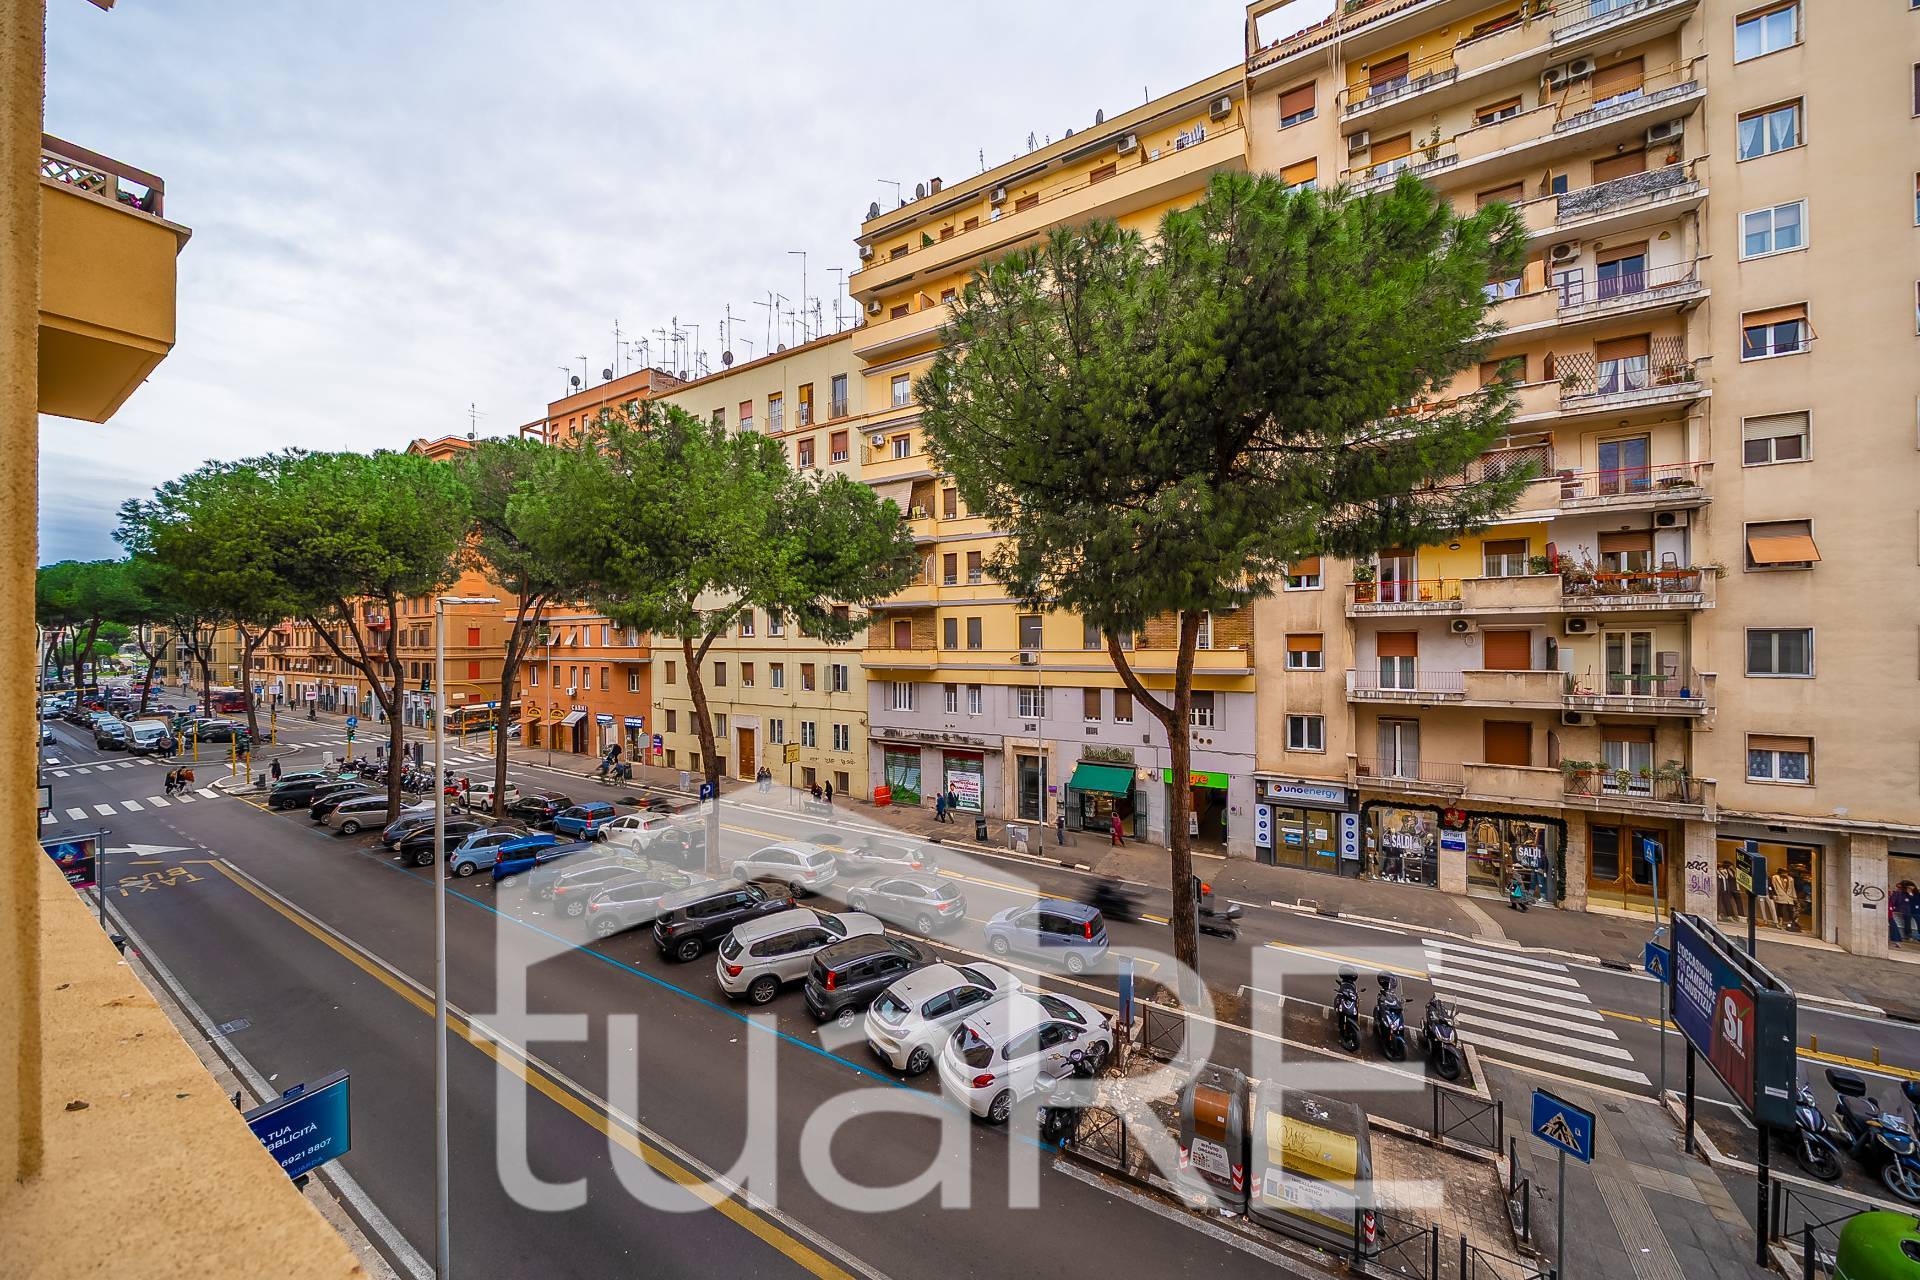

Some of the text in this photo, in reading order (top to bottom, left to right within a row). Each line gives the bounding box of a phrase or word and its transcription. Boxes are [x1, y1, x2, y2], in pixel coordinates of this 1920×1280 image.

[1189, 774, 1208, 786] gre
[1283, 786, 1338, 799] unoenergy
[1391, 834, 1413, 849] SALDI
[1518, 846, 1541, 859] SALDI
[1677, 940, 1713, 986] L'OCCASIONE
[1677, 954, 1717, 1004] PER CAMBIARE
[1677, 969, 1712, 1015] LA GIUSTIZIA
[267, 1126, 291, 1141] TUA
[267, 1122, 318, 1152] BBLICITÀ
[281, 1137, 332, 1168] 6921 8807
[1299, 1185, 1323, 1197] PLASTICA
